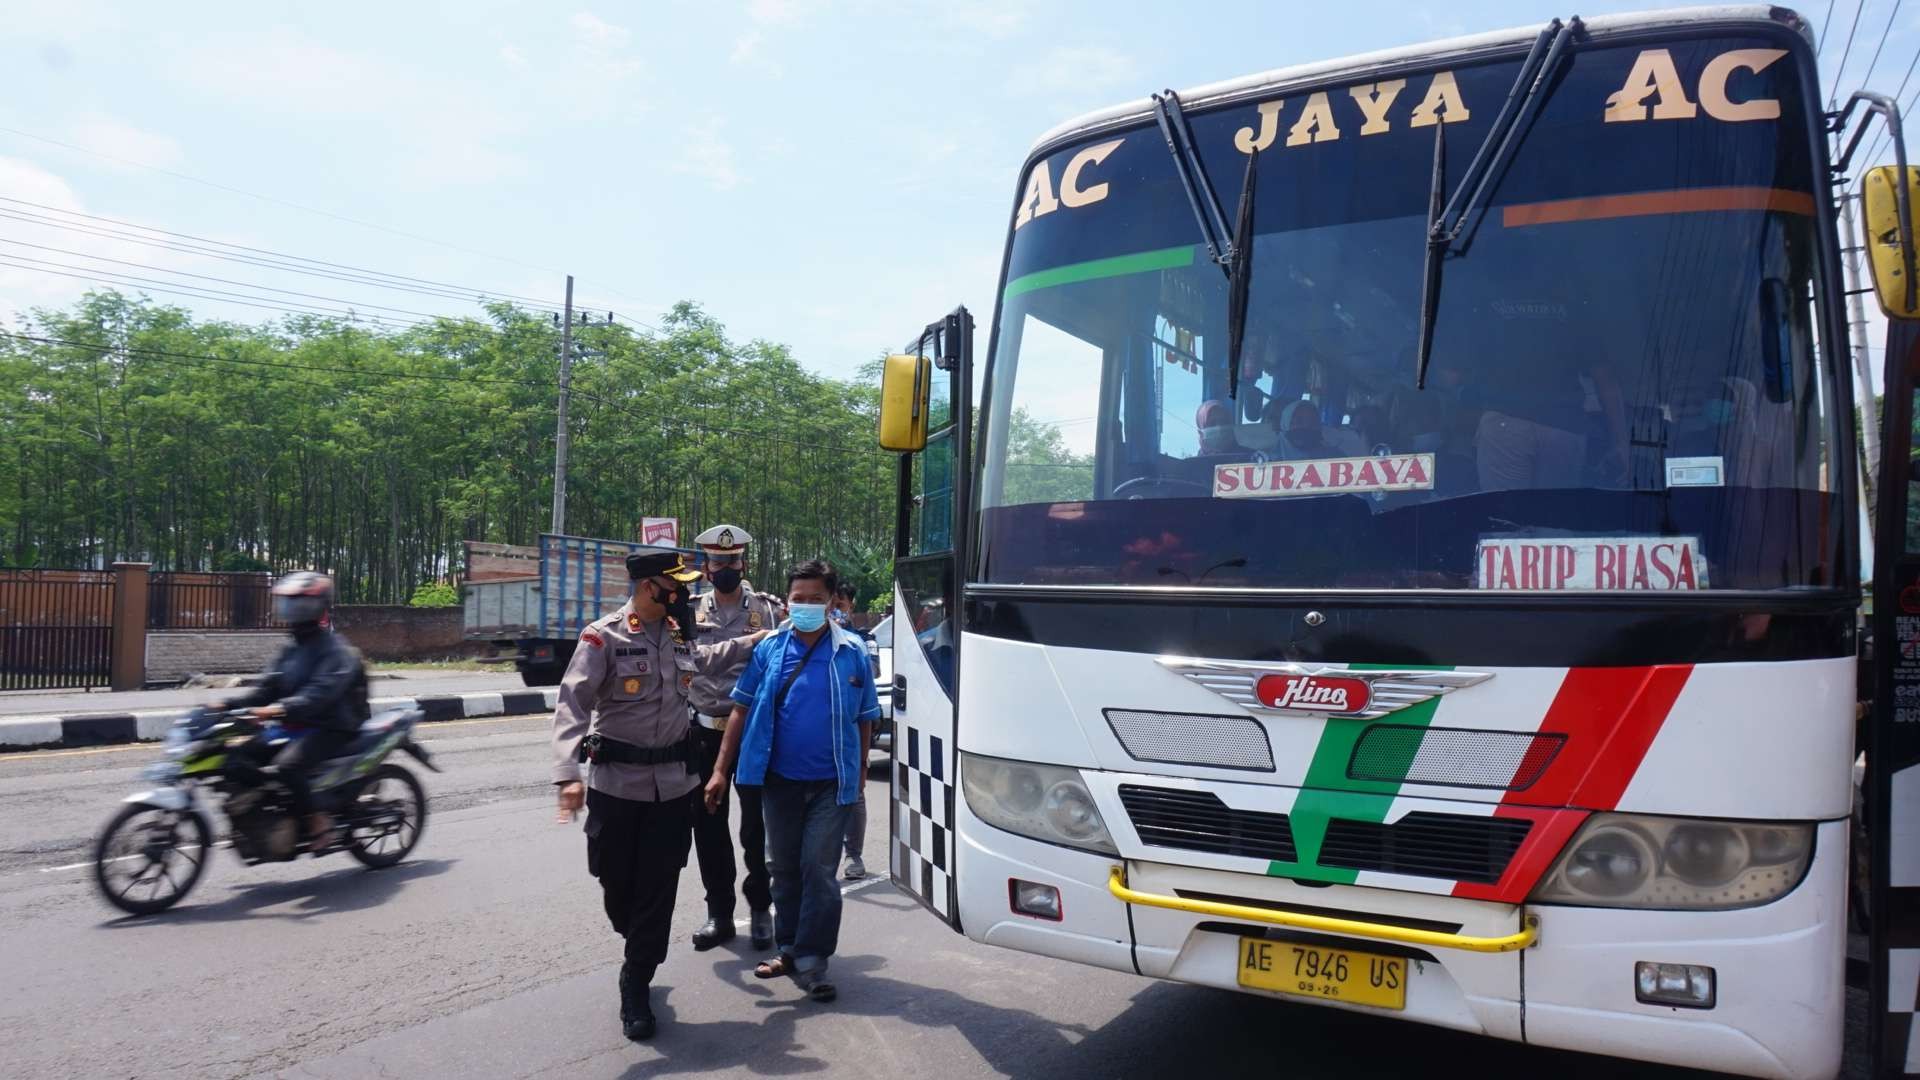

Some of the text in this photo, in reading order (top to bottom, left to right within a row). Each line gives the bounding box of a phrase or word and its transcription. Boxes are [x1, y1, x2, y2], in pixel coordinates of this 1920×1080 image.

[1604, 48, 1791, 123] AC
[1234, 71, 1470, 154] JAYA
[1015, 138, 1126, 231] AC
[1216, 457, 1428, 492] SURABAYA
[1481, 543, 1696, 590] TARIP BIASA
[1275, 676, 1349, 711] Hino
[1245, 941, 1400, 990] AE 7946 US
